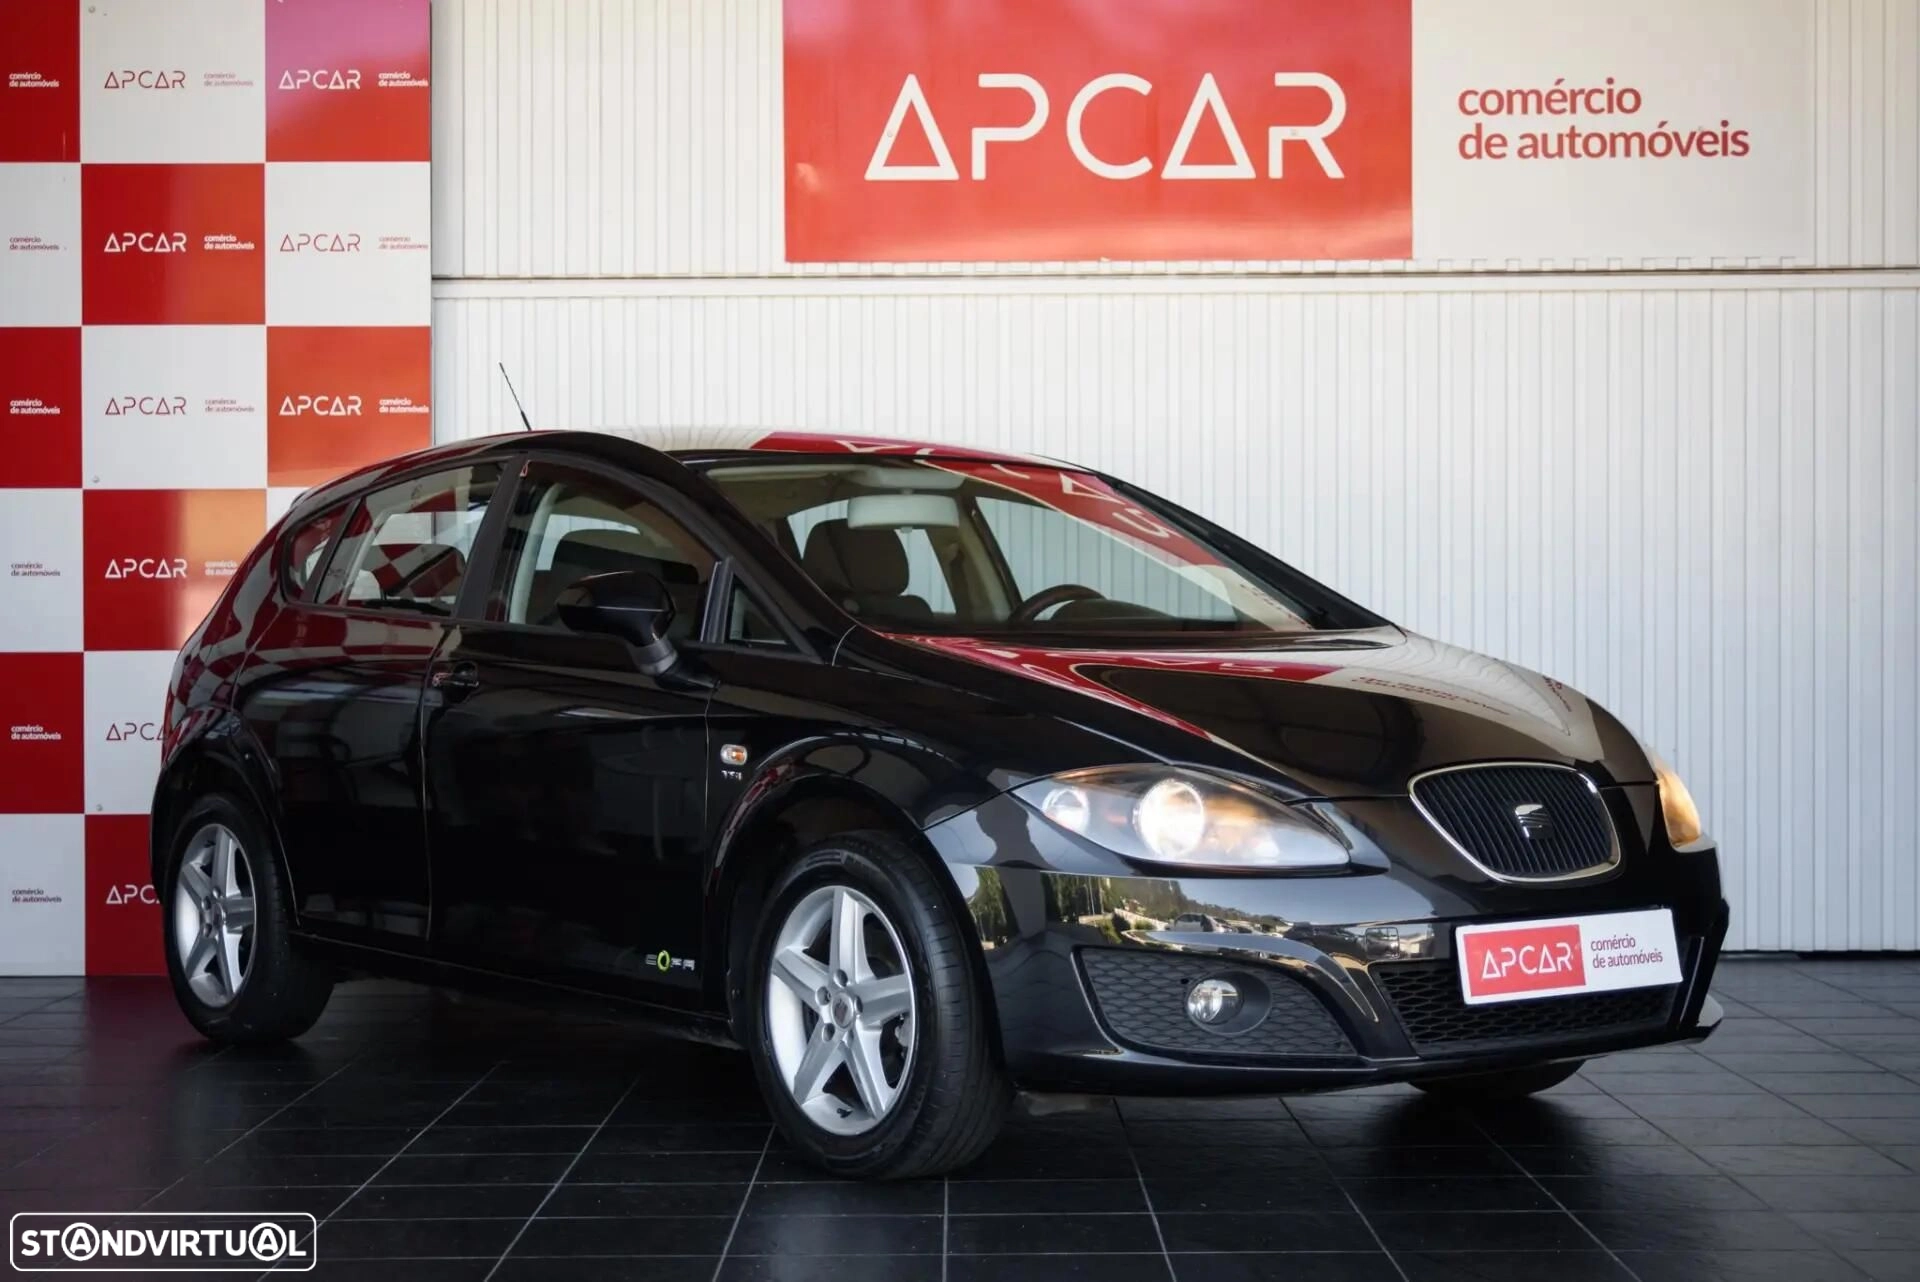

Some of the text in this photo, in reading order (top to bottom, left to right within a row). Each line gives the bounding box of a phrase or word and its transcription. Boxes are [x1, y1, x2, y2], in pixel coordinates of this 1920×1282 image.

[9, 72, 41, 80] comércio
[9, 80, 60, 88] de automóveis
[104, 70, 186, 89] APCAR
[278, 69, 361, 90] APCAR
[378, 79, 388, 87] de
[1458, 77, 1642, 116] comércio
[864, 72, 1347, 180] APCAR
[1458, 120, 1750, 160] de automóveis
[103, 232, 188, 253] APCAR
[204, 234, 237, 242] comércio
[204, 242, 255, 250] de automóveis
[280, 233, 361, 253] APCAR
[10, 398, 42, 406] comércio
[10, 406, 60, 414] de automóveis
[105, 396, 187, 415] APCAR
[279, 396, 362, 416] APCAR
[379, 397, 412, 406] comércio
[379, 405, 429, 413] de automóveis
[11, 569, 20, 577] de
[104, 558, 188, 579] APCAR
[11, 725, 43, 733] comércio
[11, 732, 62, 740] de automóveis
[12, 895, 20, 903] de
[106, 884, 160, 905] APC
[1591, 934, 1636, 952] comércio
[1481, 942, 1573, 979] APCAR
[1593, 948, 1664, 969] de automóveis
